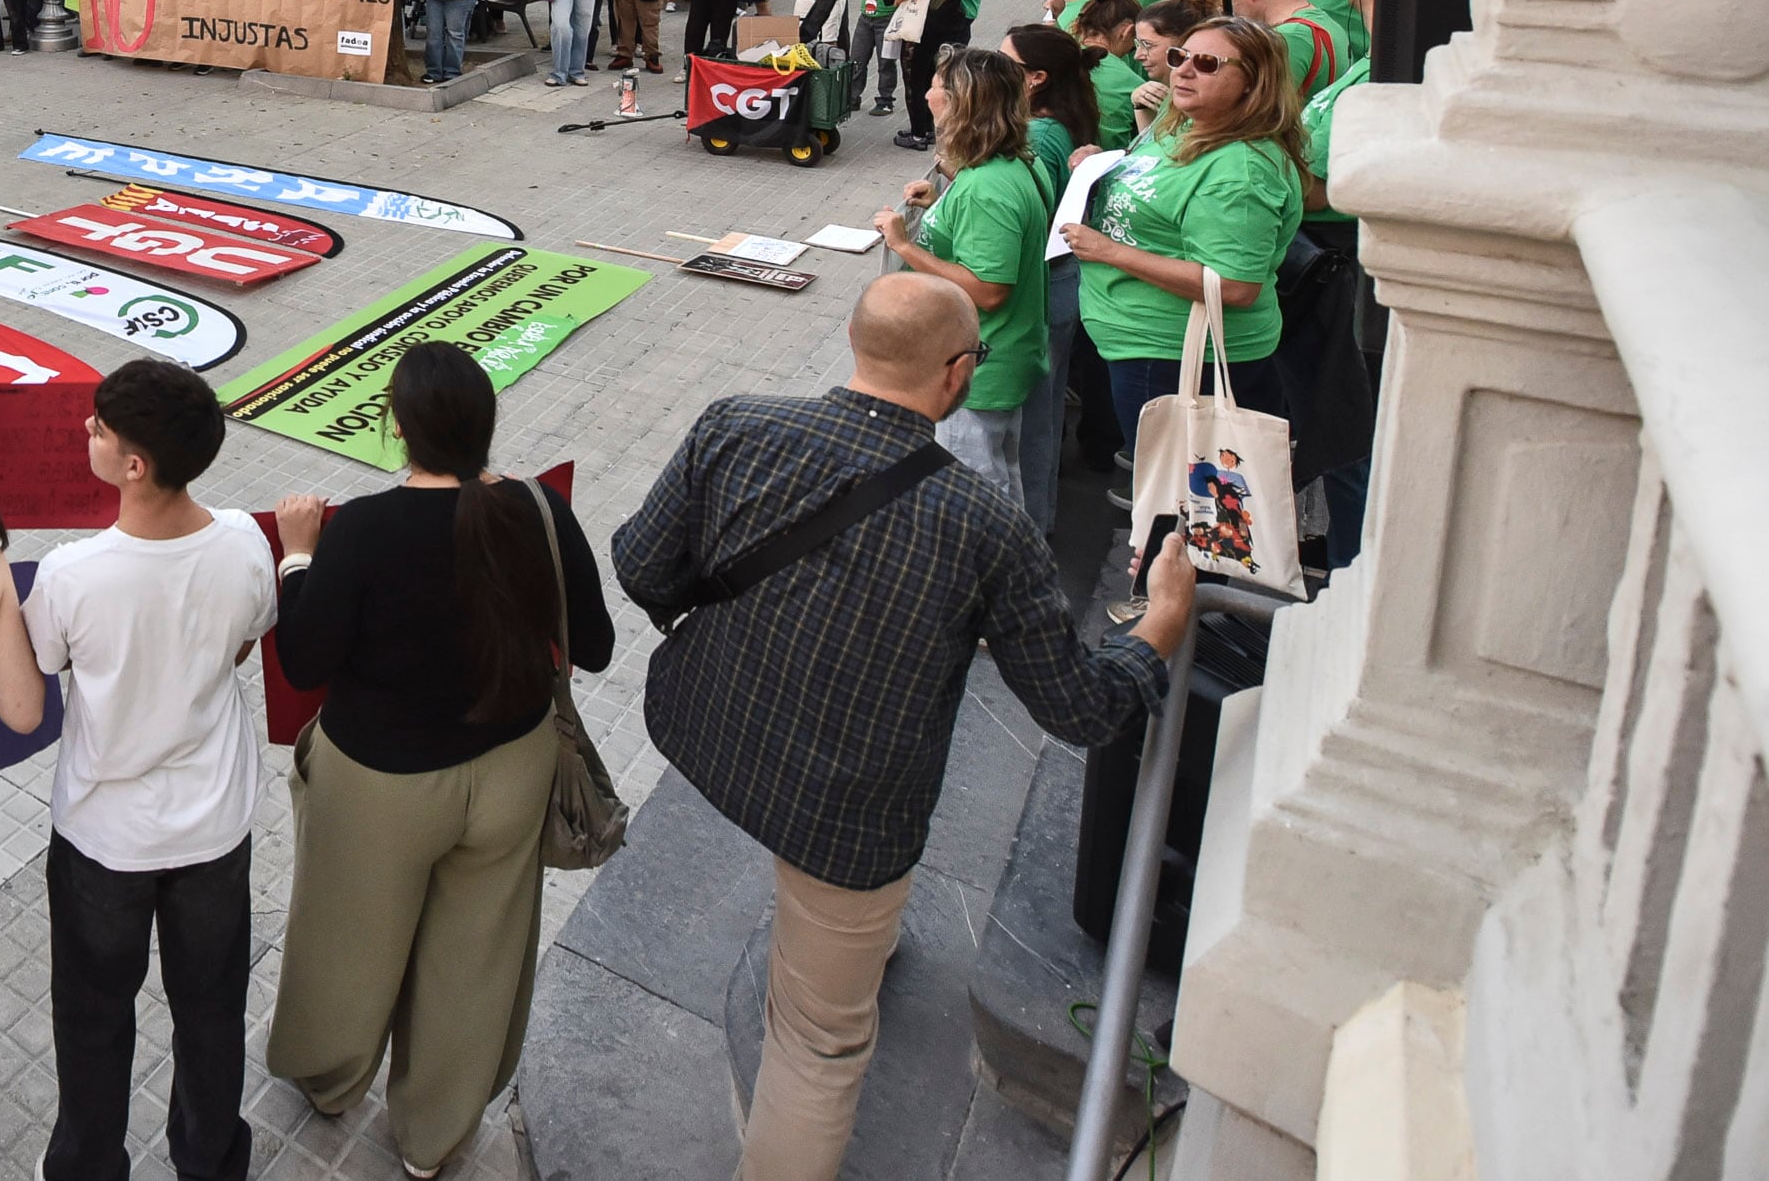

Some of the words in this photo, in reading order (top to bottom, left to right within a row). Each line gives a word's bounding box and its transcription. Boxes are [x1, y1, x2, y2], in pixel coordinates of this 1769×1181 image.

[181, 16, 309, 51] INJUSTAS
[710, 82, 799, 120] CGT
[57, 217, 294, 275] UGT
[469, 263, 539, 302] QUEREMOS
[549, 264, 598, 286] POR
[527, 284, 569, 301] UN
[123, 305, 181, 337] CSIF
[421, 299, 479, 330] APOYO,
[466, 299, 543, 342] CAMBIO
[308, 353, 341, 373] puede
[338, 346, 354, 356] no
[357, 331, 430, 372] CONSEJO
[452, 340, 482, 355] E
[292, 371, 312, 385] ser
[345, 371, 369, 381] Y
[232, 381, 294, 419] sancionado
[284, 377, 352, 414] AYUDA
